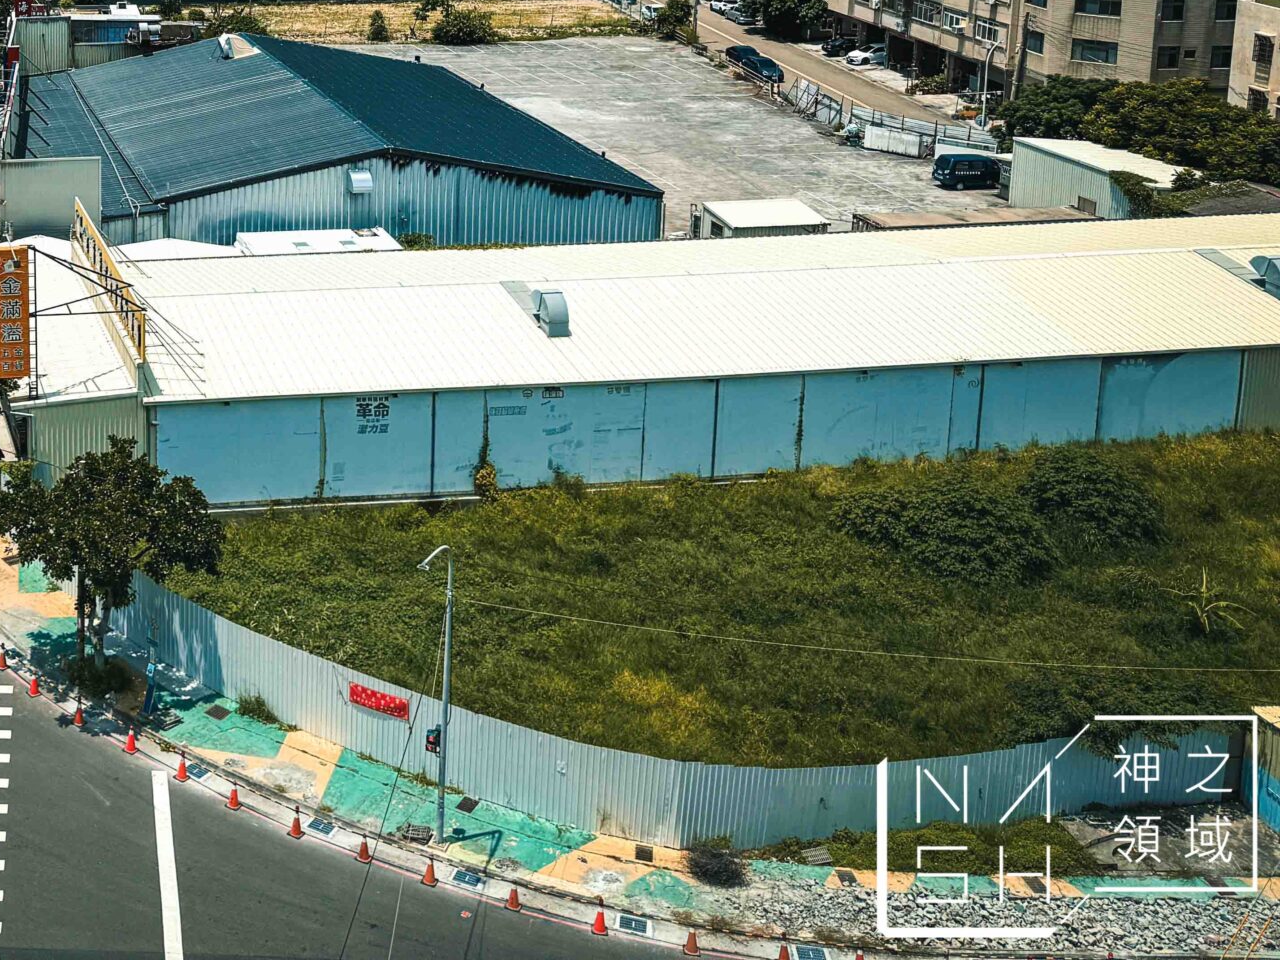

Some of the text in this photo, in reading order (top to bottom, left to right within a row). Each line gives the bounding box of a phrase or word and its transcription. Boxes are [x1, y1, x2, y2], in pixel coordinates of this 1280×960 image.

[0, 275, 23, 343] 金滿溢
[355, 403, 390, 419] 革命
